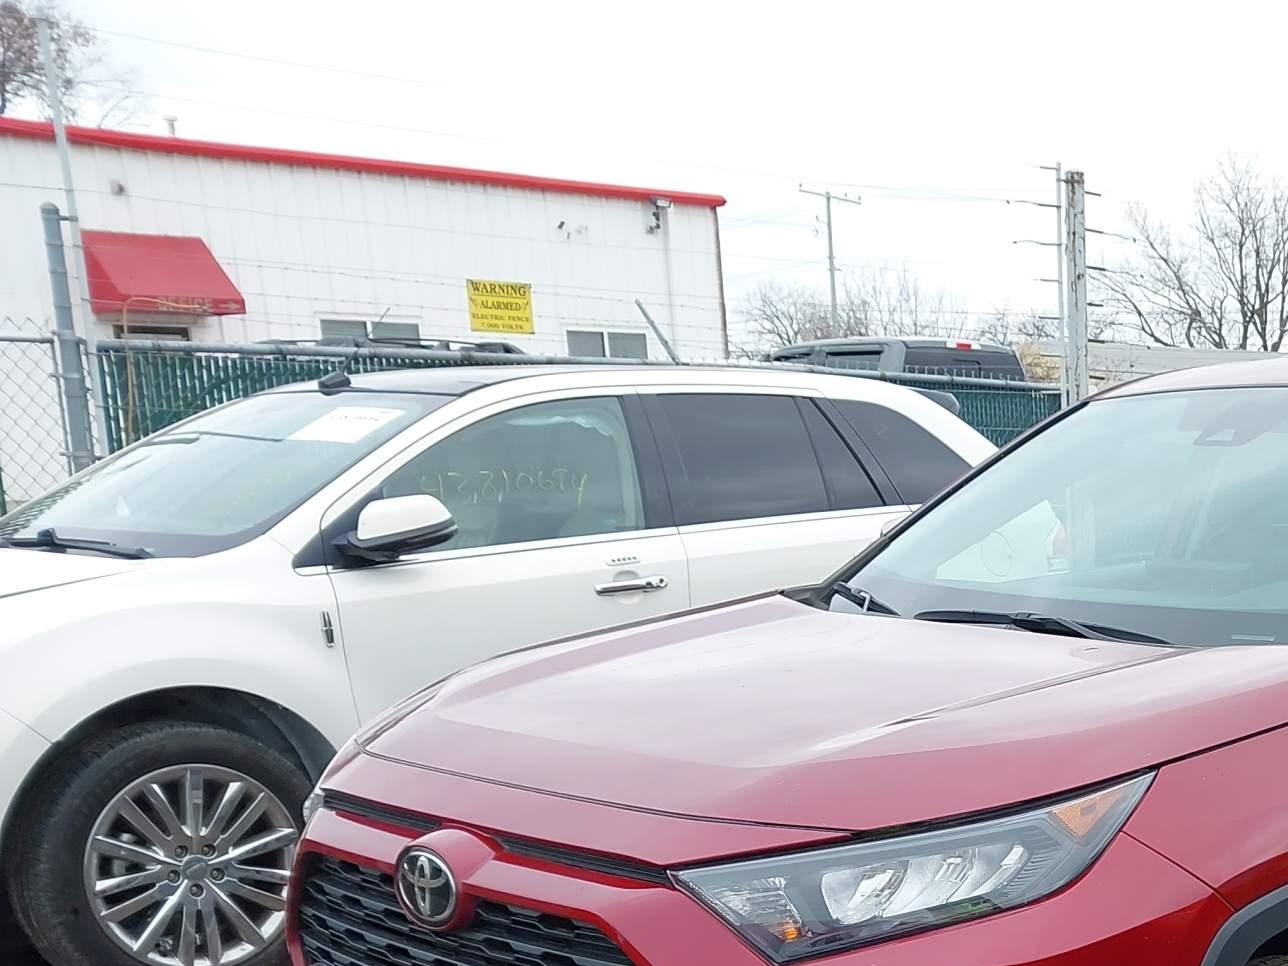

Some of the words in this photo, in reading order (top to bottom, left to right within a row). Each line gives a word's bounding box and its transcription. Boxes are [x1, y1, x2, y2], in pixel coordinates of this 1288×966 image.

[471, 281, 526, 296] WARNING
[480, 300, 521, 311] ALARMED
[472, 313, 505, 321] ELECTRIC
